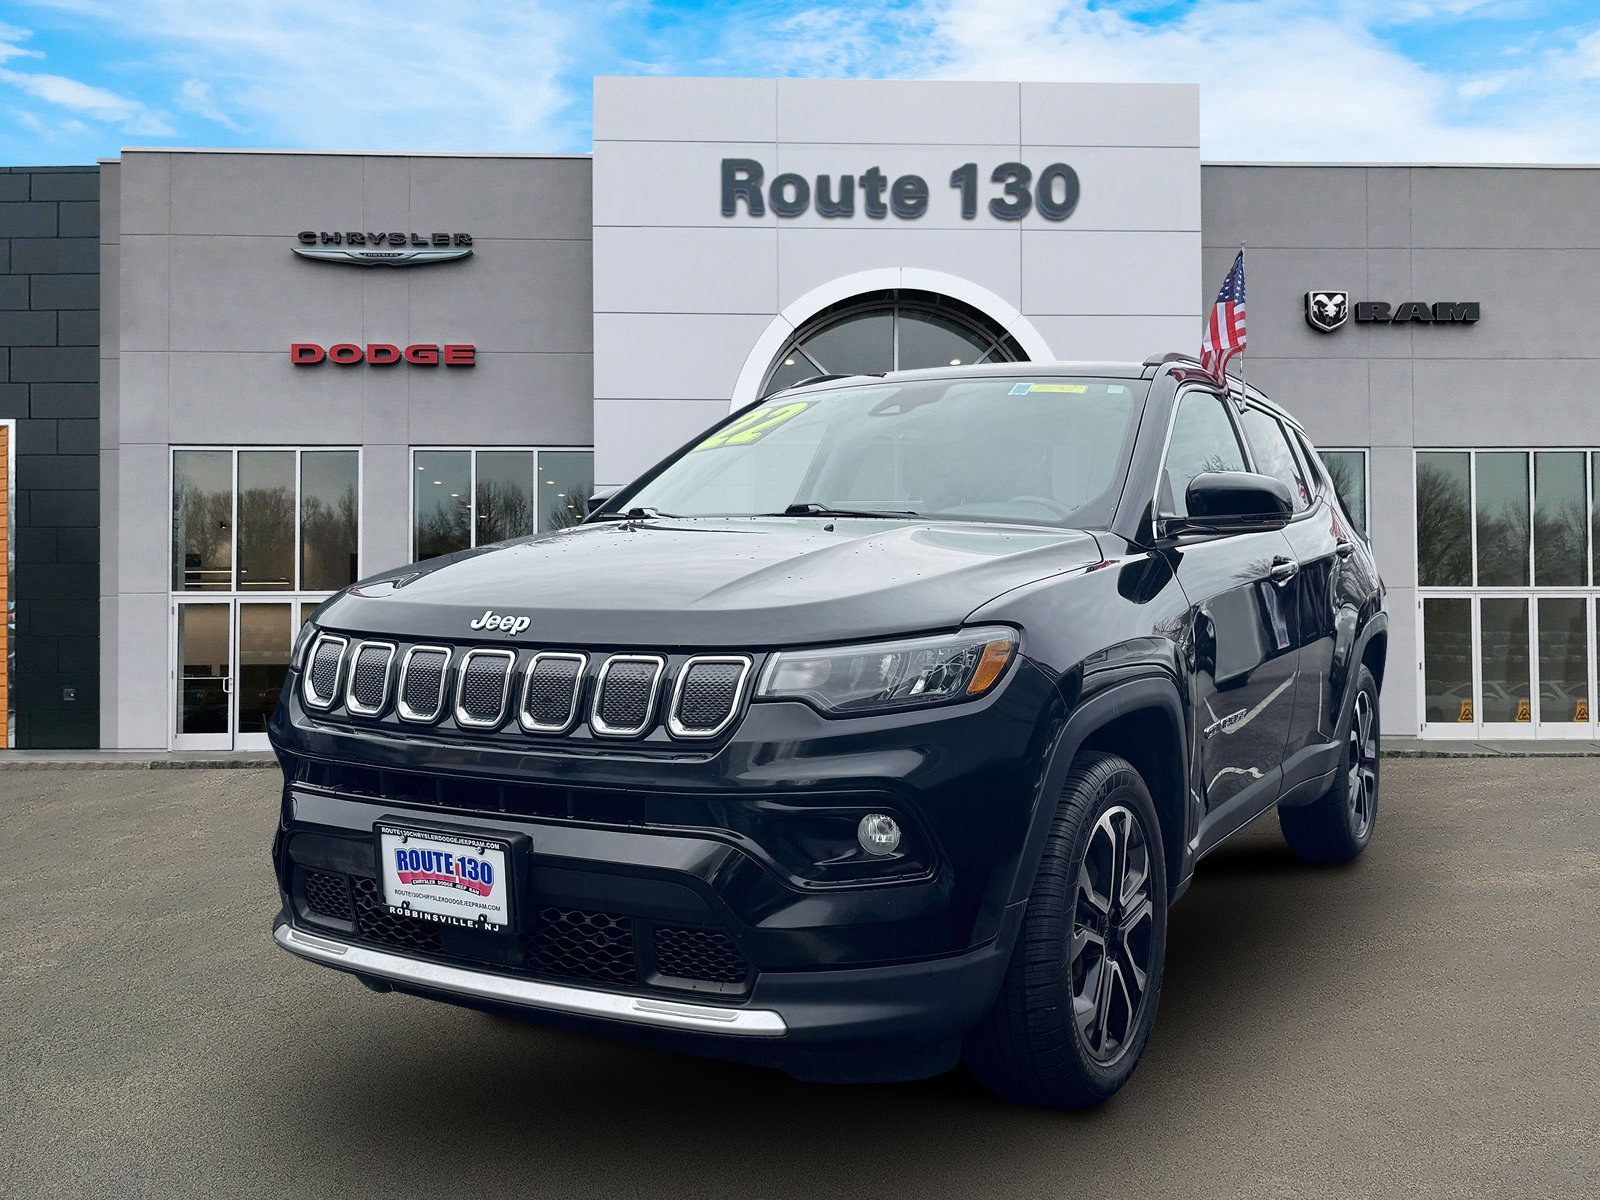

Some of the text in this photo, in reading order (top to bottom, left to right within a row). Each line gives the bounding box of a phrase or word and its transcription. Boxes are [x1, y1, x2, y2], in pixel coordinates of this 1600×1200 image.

[721, 158, 1081, 221] Route 130
[297, 231, 473, 246] CHRYSLER
[1354, 302, 1480, 325] RAM
[290, 343, 477, 366] DODGE
[694, 402, 809, 451] 22
[470, 610, 532, 636] Jeep
[396, 849, 493, 885] ROUTE 130
[389, 906, 500, 932] ROBBINSVILLE, NJ
